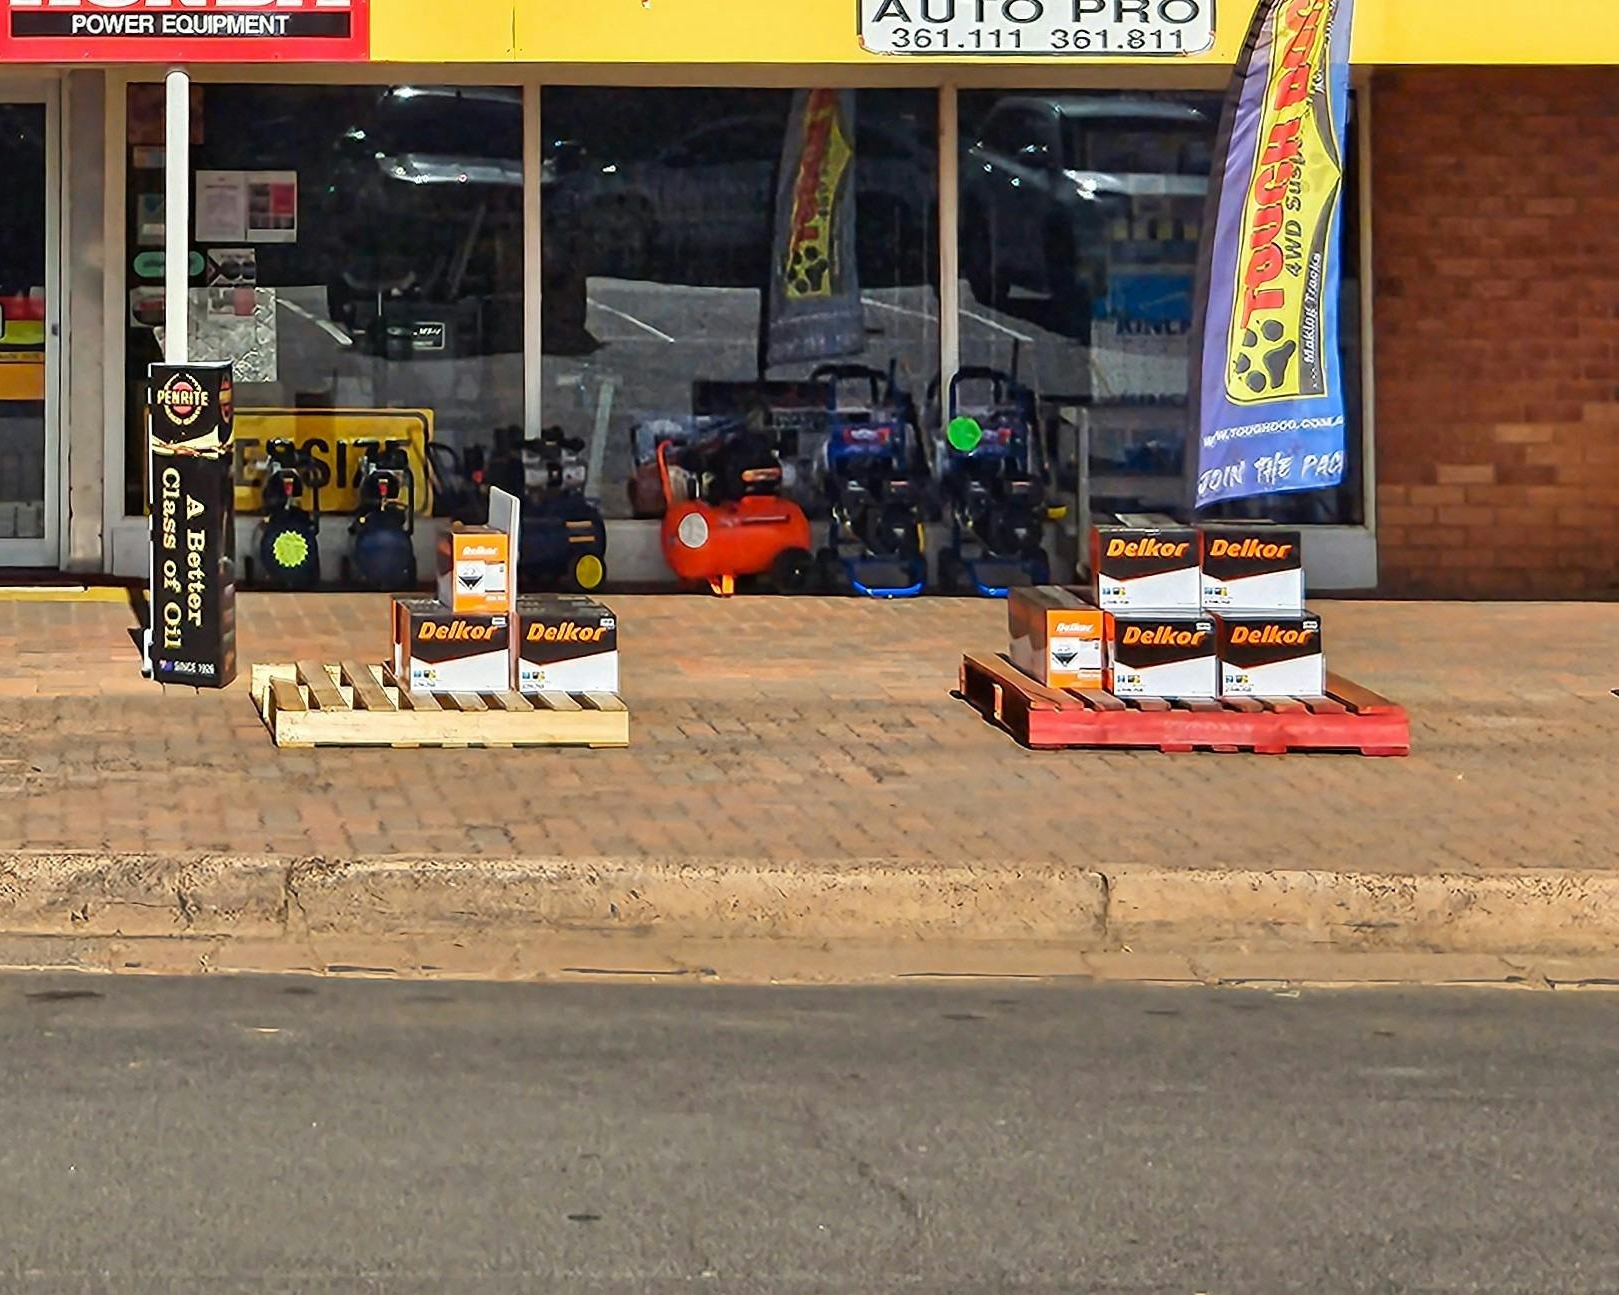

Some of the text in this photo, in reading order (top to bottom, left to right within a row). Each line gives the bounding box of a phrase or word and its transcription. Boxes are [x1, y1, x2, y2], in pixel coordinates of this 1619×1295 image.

[71, 14, 290, 35] POWER EQUIPMENT
[891, 28, 1183, 50] 361.111 361.811
[1241, 117, 1301, 329] TOUGH
[1284, 218, 1303, 277] 4WD
[156, 389, 209, 407] PENRITE
[1197, 451, 1344, 497] JOIN THE PAC
[161, 467, 183, 649] Class of Oil
[1106, 537, 1191, 559] Delkor
[1210, 538, 1293, 560] Delkor
[186, 494, 207, 628] A Better
[417, 620, 498, 642] Delkor
[526, 621, 608, 643] Delkor
[1122, 625, 1206, 646] Delkor
[1230, 624, 1309, 646] Delkor
[173, 660, 197, 674] SINCE
